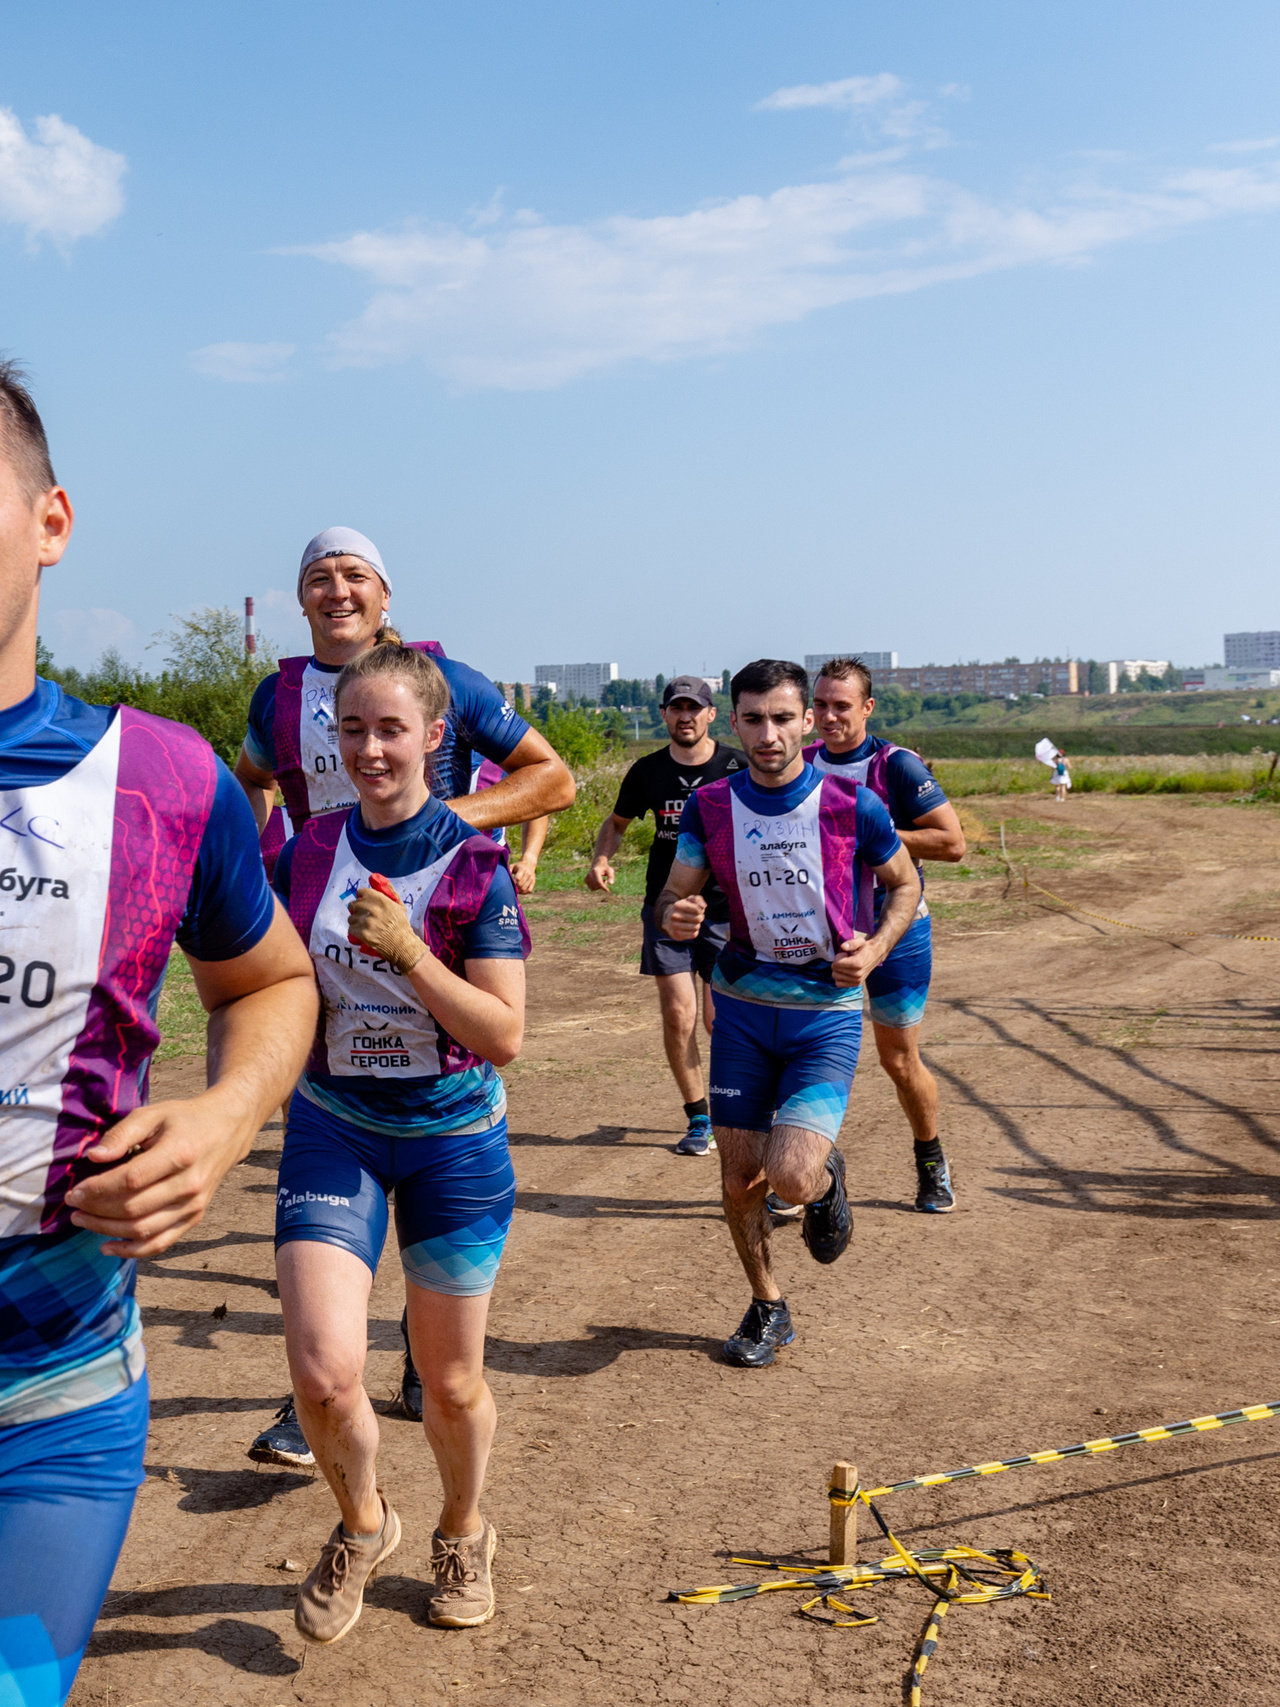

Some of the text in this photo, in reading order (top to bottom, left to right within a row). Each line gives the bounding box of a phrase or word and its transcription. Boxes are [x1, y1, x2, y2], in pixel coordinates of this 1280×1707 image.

[743, 819, 816, 838] ГРУЗИН
[760, 840, 807, 852] алабуга
[749, 868, 810, 887] 01-20
[772, 908, 816, 919] АММОНИЙ
[774, 937, 812, 947] ГОНКА
[774, 947, 818, 959] ГЕРОЕВ
[352, 1036, 405, 1049] ГОНКА
[350, 1055, 411, 1068] ГЕРОЕВ
[284, 1190, 350, 1208] alabuga
